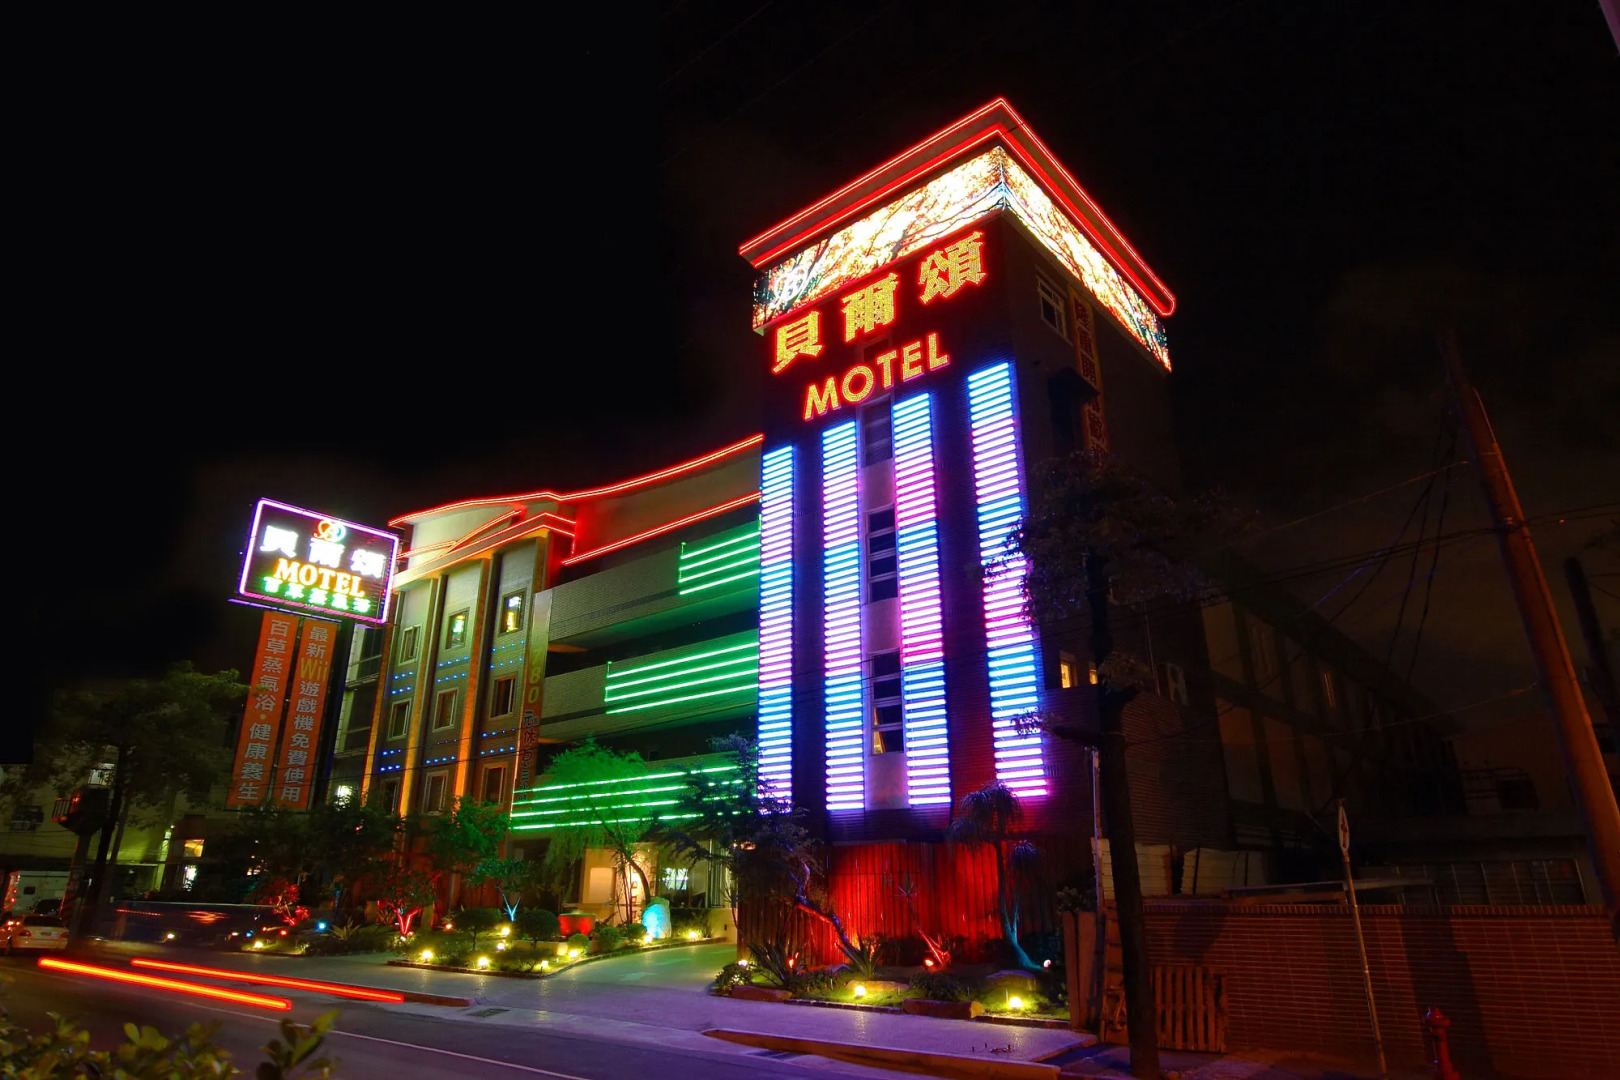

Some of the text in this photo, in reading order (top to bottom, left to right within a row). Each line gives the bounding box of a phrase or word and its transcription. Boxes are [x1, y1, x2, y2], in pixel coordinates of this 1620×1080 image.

[771, 230, 987, 374] 貝爾頌
[803, 332, 951, 421] MOTEL
[273, 558, 366, 598] MOTEL
